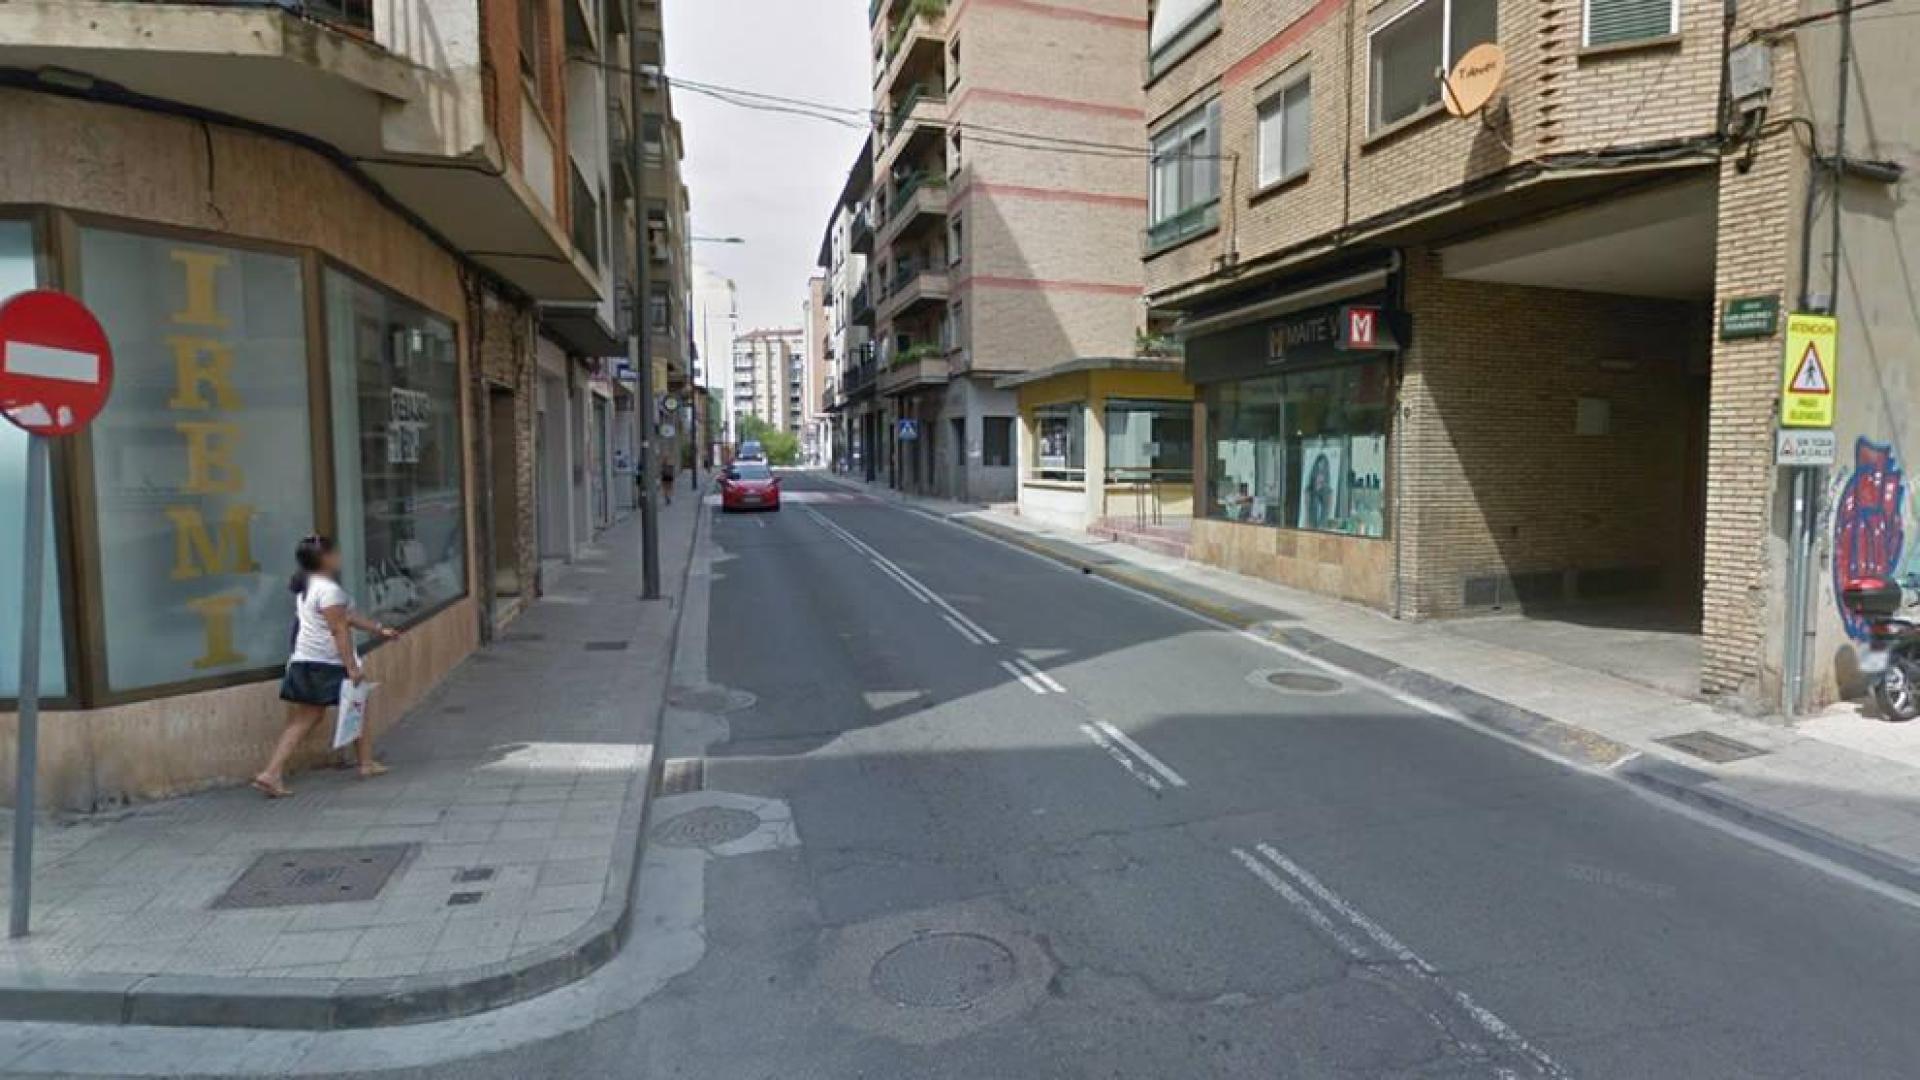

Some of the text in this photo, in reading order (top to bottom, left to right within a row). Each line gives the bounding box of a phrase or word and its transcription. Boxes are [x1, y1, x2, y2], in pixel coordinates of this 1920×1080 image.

[1288, 317, 1328, 344] MAITE
[1350, 312, 1373, 342] M
[166, 250, 260, 669] IREMI
